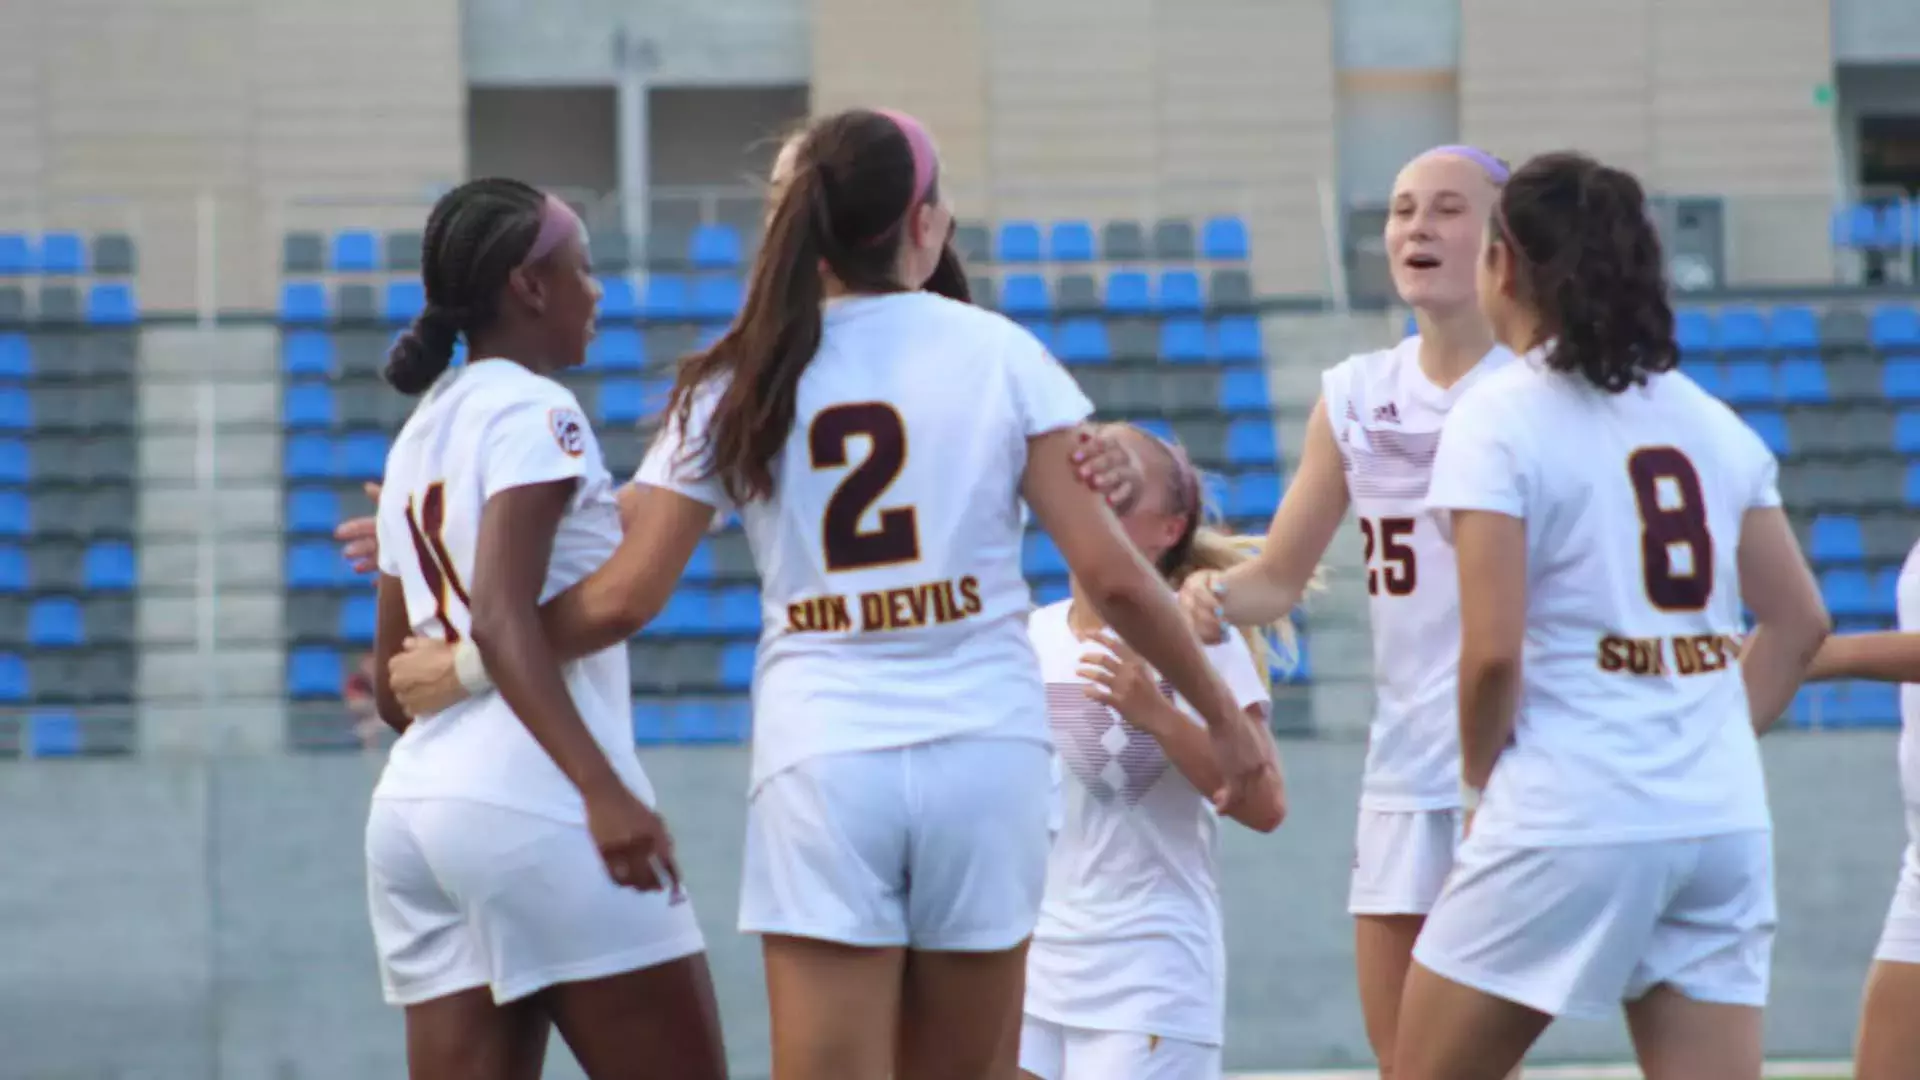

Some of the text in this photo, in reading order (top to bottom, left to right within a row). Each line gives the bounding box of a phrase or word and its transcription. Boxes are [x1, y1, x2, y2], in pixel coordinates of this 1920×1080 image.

[809, 400, 921, 573] 2
[1626, 445, 1716, 614] 8
[859, 574, 982, 632] DEVILS
